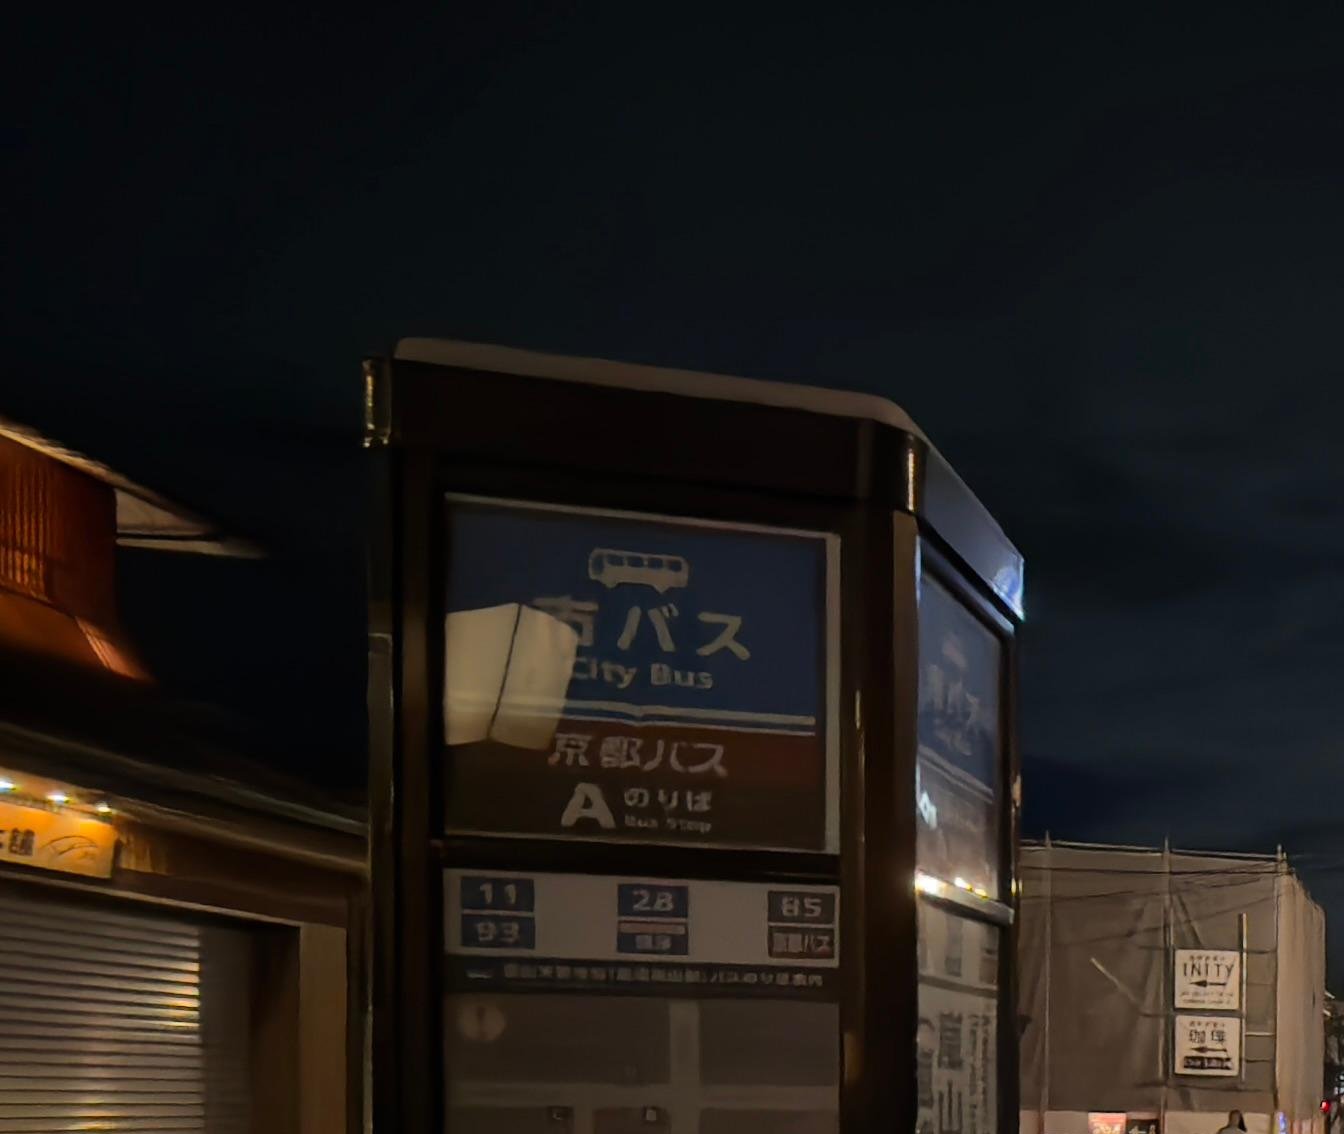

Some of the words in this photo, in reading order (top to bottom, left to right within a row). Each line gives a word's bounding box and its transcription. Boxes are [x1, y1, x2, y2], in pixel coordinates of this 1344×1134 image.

[532, 595, 750, 661] 市バス
[650, 663, 714, 690] Bus
[547, 732, 728, 778] 京都バス
[560, 782, 616, 830] A
[624, 786, 713, 812] のりば
[479, 882, 517, 906] 11
[631, 888, 676, 913] 28
[781, 896, 823, 919] 85
[474, 921, 521, 944] 93
